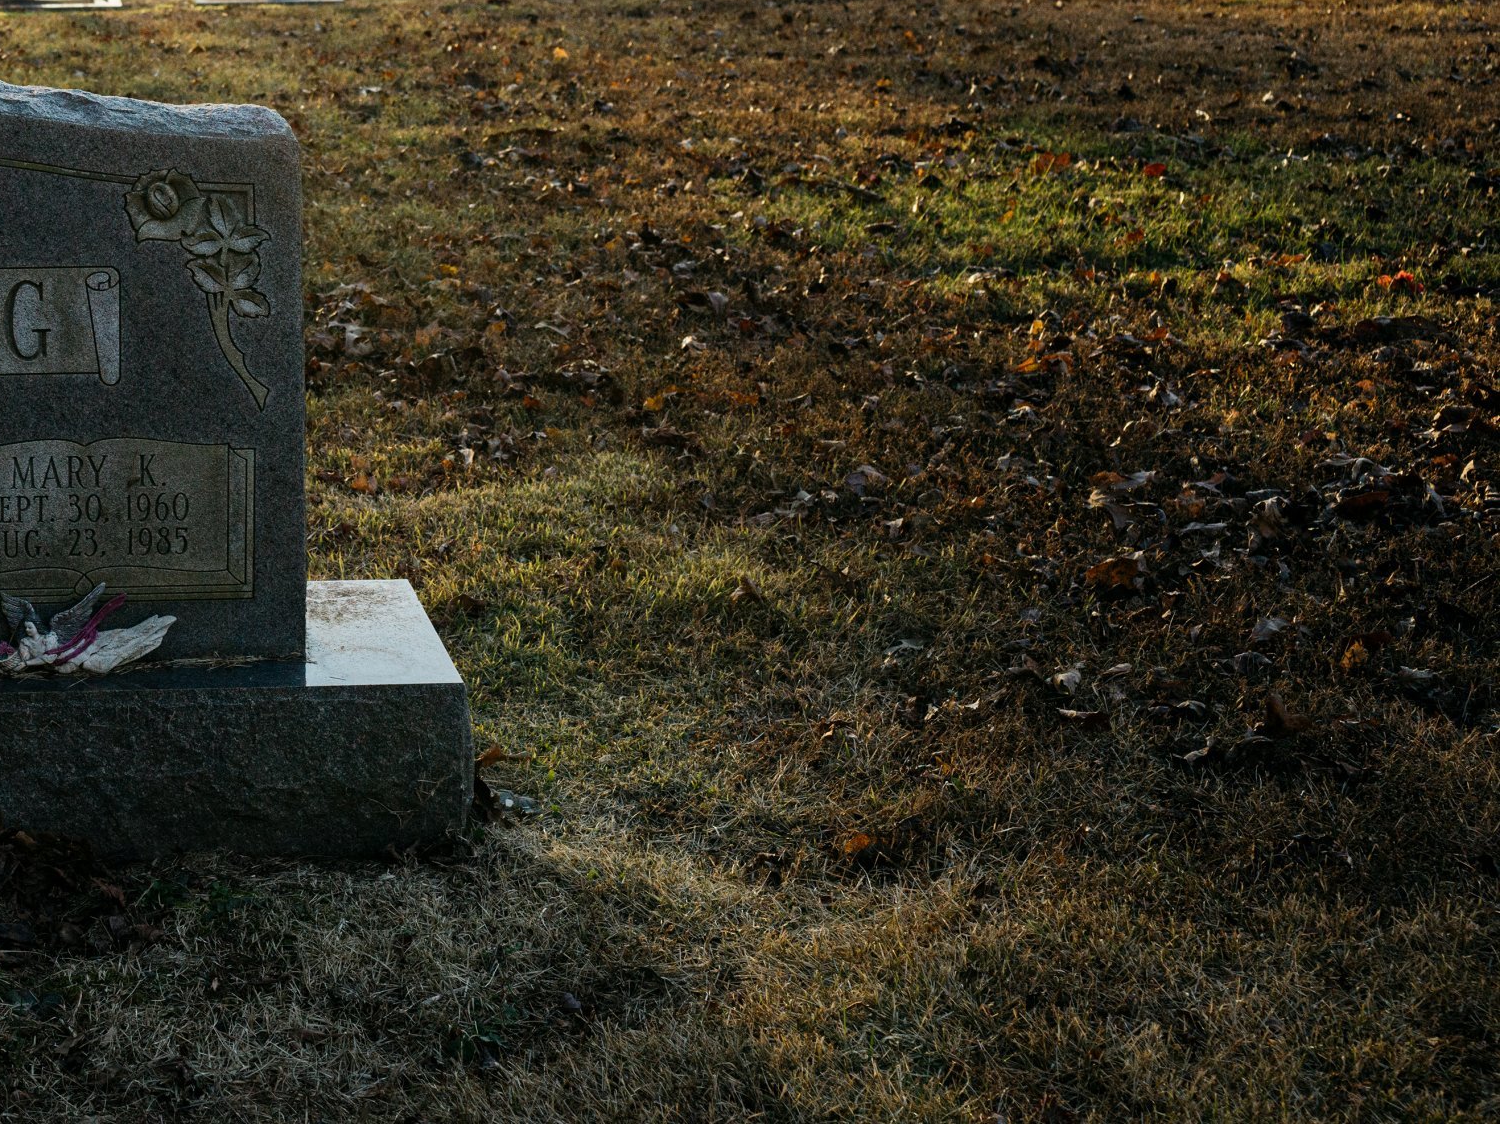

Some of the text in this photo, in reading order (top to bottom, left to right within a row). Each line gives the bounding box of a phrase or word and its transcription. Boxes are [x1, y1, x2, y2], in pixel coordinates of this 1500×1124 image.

[11, 453, 167, 490] MARY K.
[68, 493, 110, 524] 30,
[125, 492, 190, 522] 1960
[67, 528, 107, 558] 23,
[126, 527, 190, 556] 1985
